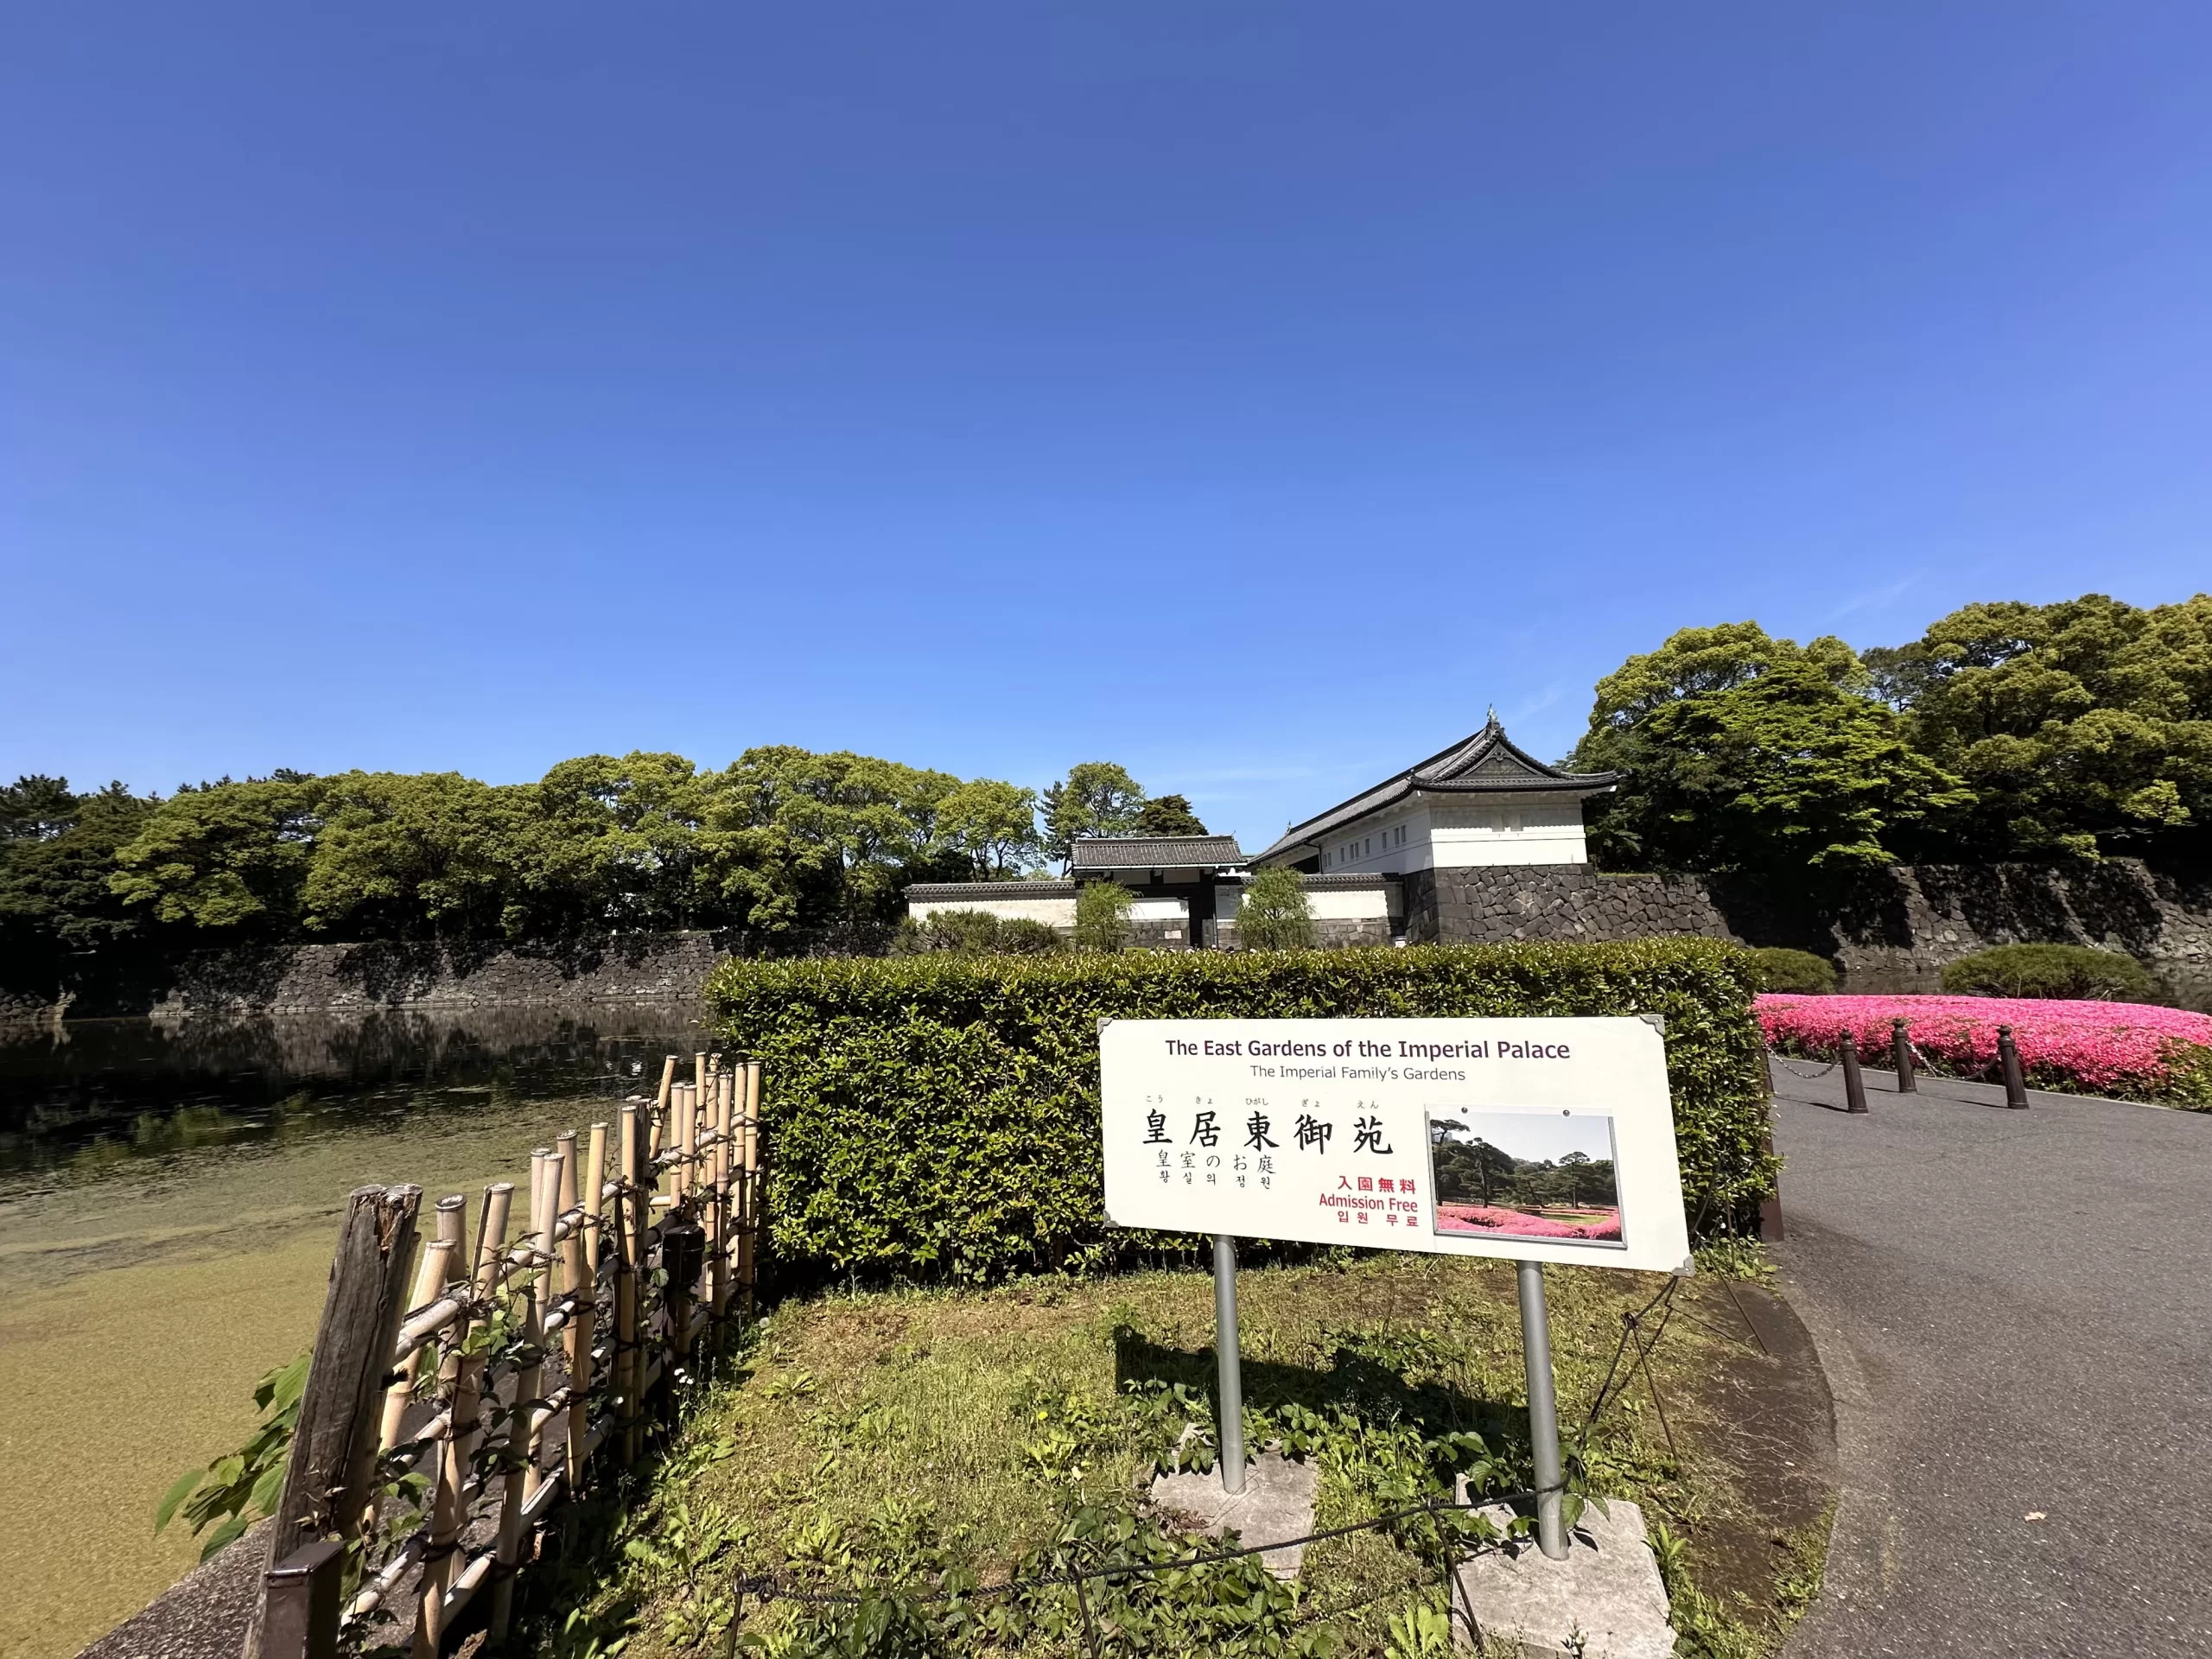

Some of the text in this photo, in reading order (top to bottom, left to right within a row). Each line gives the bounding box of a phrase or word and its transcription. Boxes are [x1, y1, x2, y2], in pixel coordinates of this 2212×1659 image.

[1165, 1039, 1571, 1063] The East Gardens of the Imperial Palace
[1249, 1065, 1465, 1082] The Imperial Family's Gardens
[1245, 1097, 1269, 1106] ひがし
[1141, 1108, 1394, 1155] 皇居東御苑
[1155, 1148, 1277, 1174] 皇室のお庭
[1236, 1174, 1271, 1190] 정원
[1338, 1175, 1416, 1195] 入園無料
[1319, 1192, 1418, 1212] Admission Free
[1386, 1214, 1419, 1227] 무료
